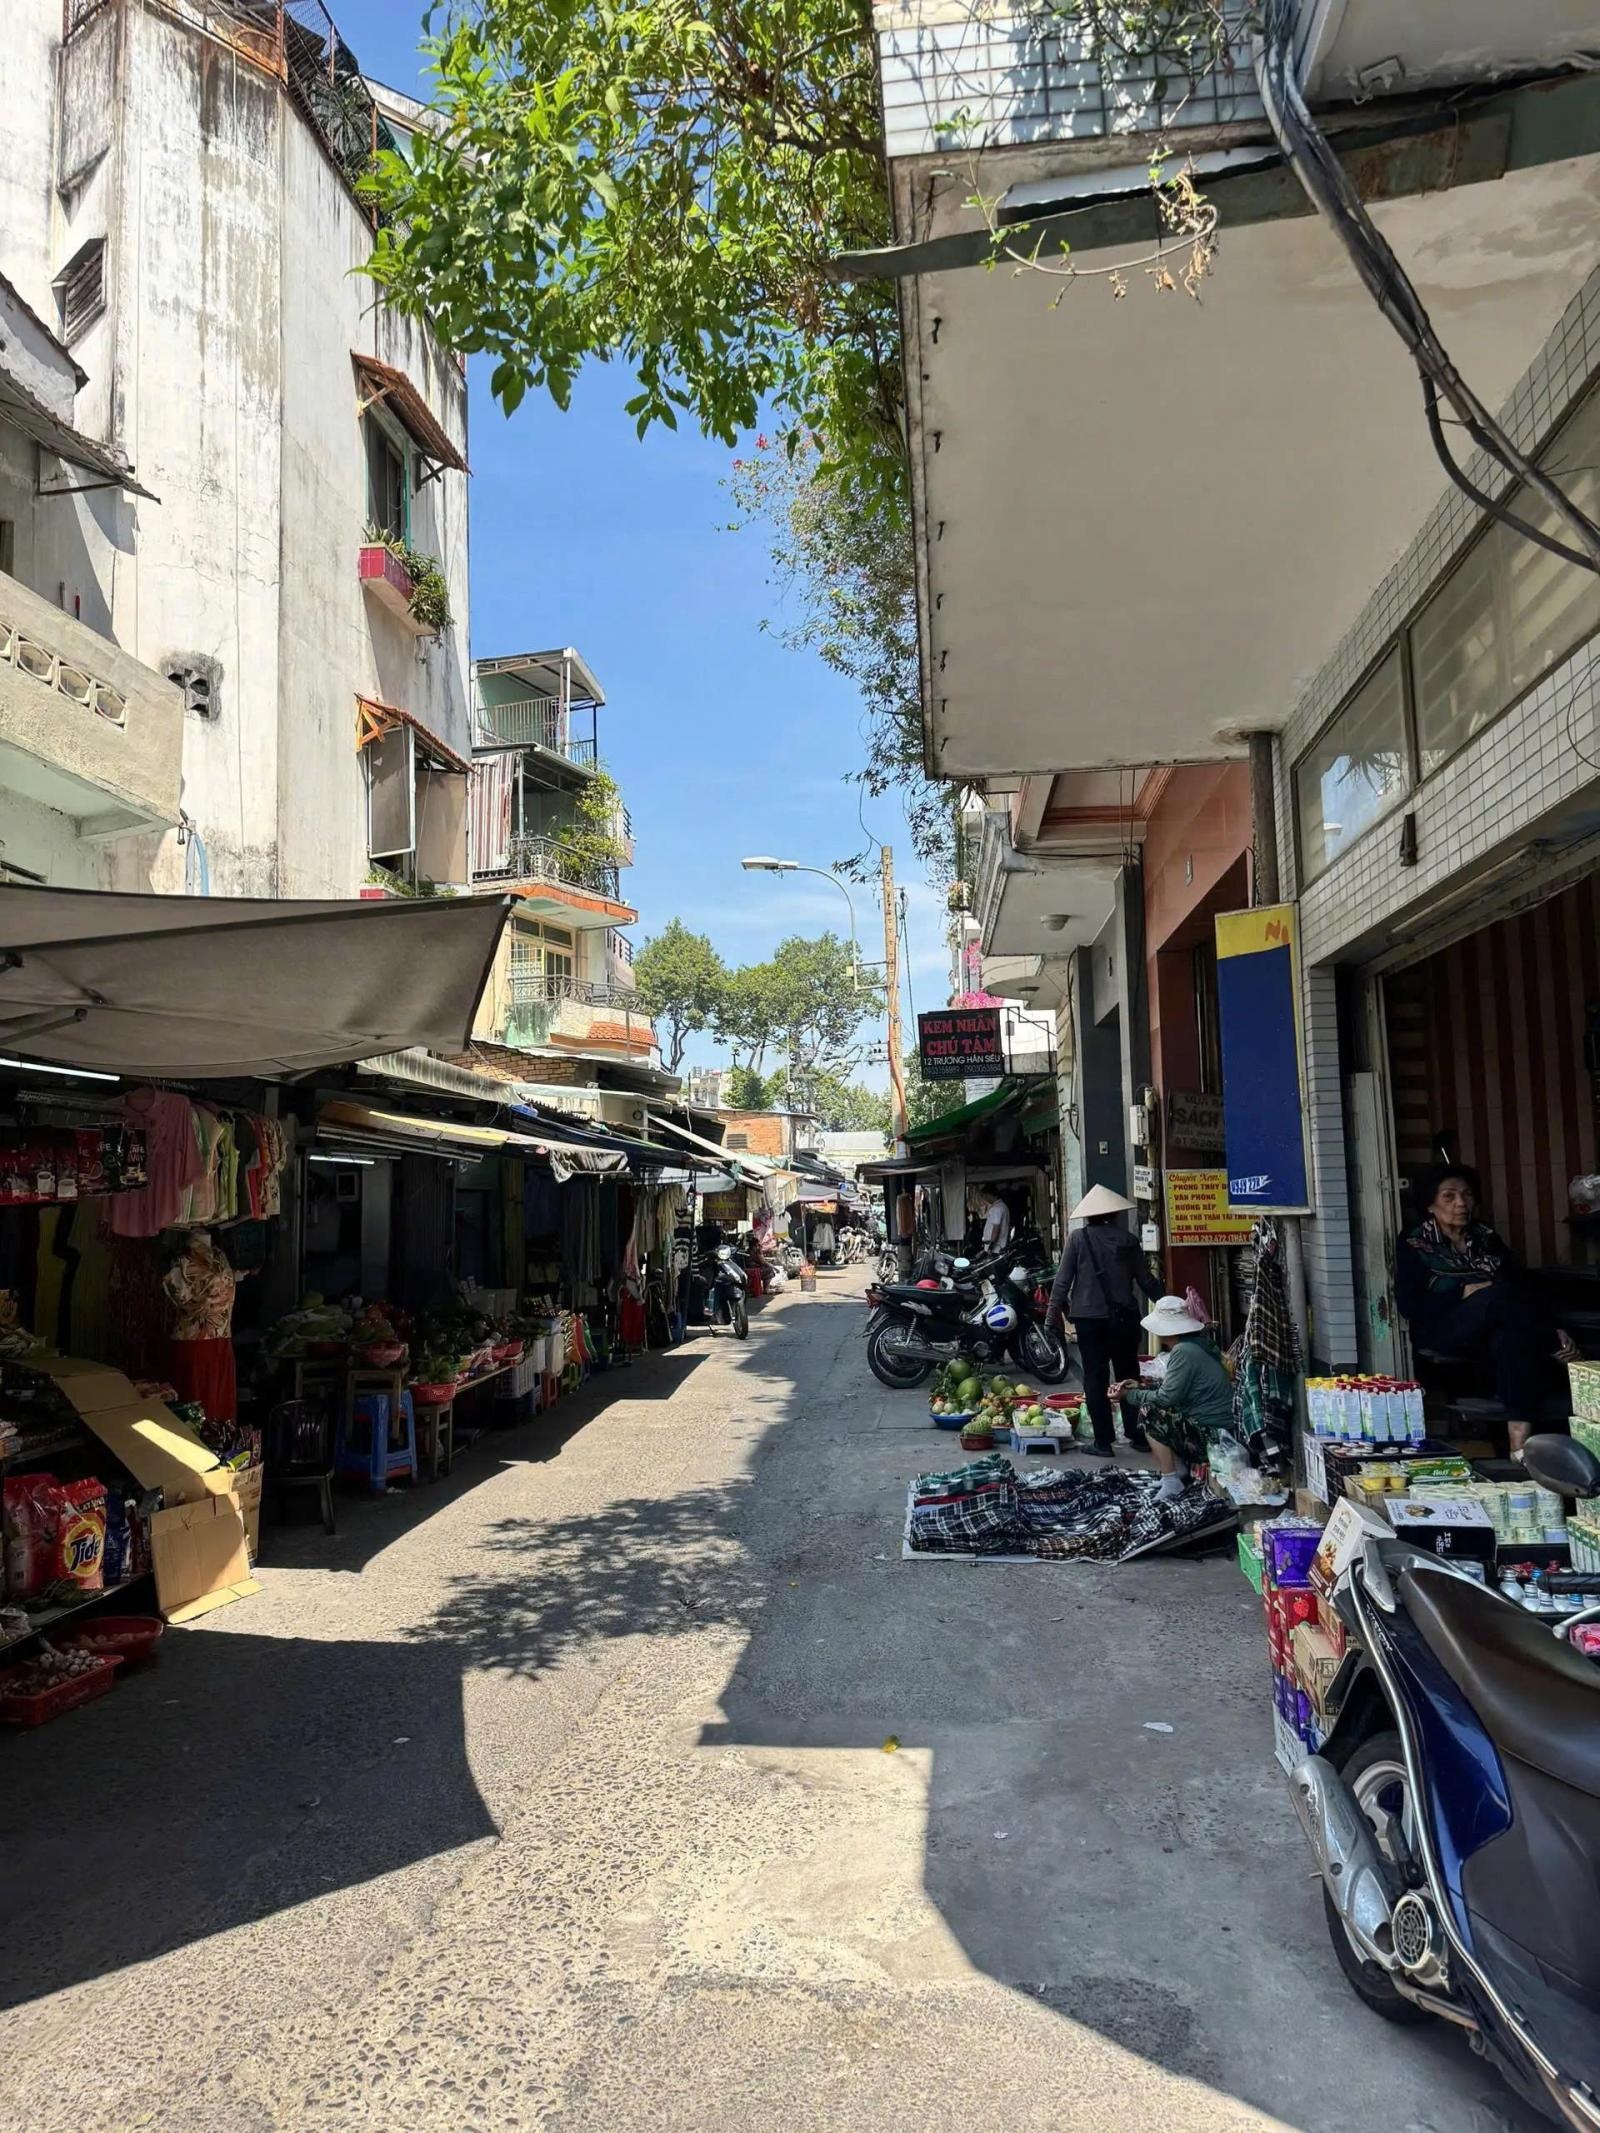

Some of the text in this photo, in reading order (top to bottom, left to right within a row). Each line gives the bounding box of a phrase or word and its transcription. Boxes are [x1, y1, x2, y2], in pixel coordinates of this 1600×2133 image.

[923, 1020, 953, 1034] KEM
[926, 1035, 997, 1056] CHÚ TÁM
[923, 1057, 933, 1066] 12
[1174, 1104, 1218, 1128] SÁCH
[69, 1533, 102, 1572] Tide
